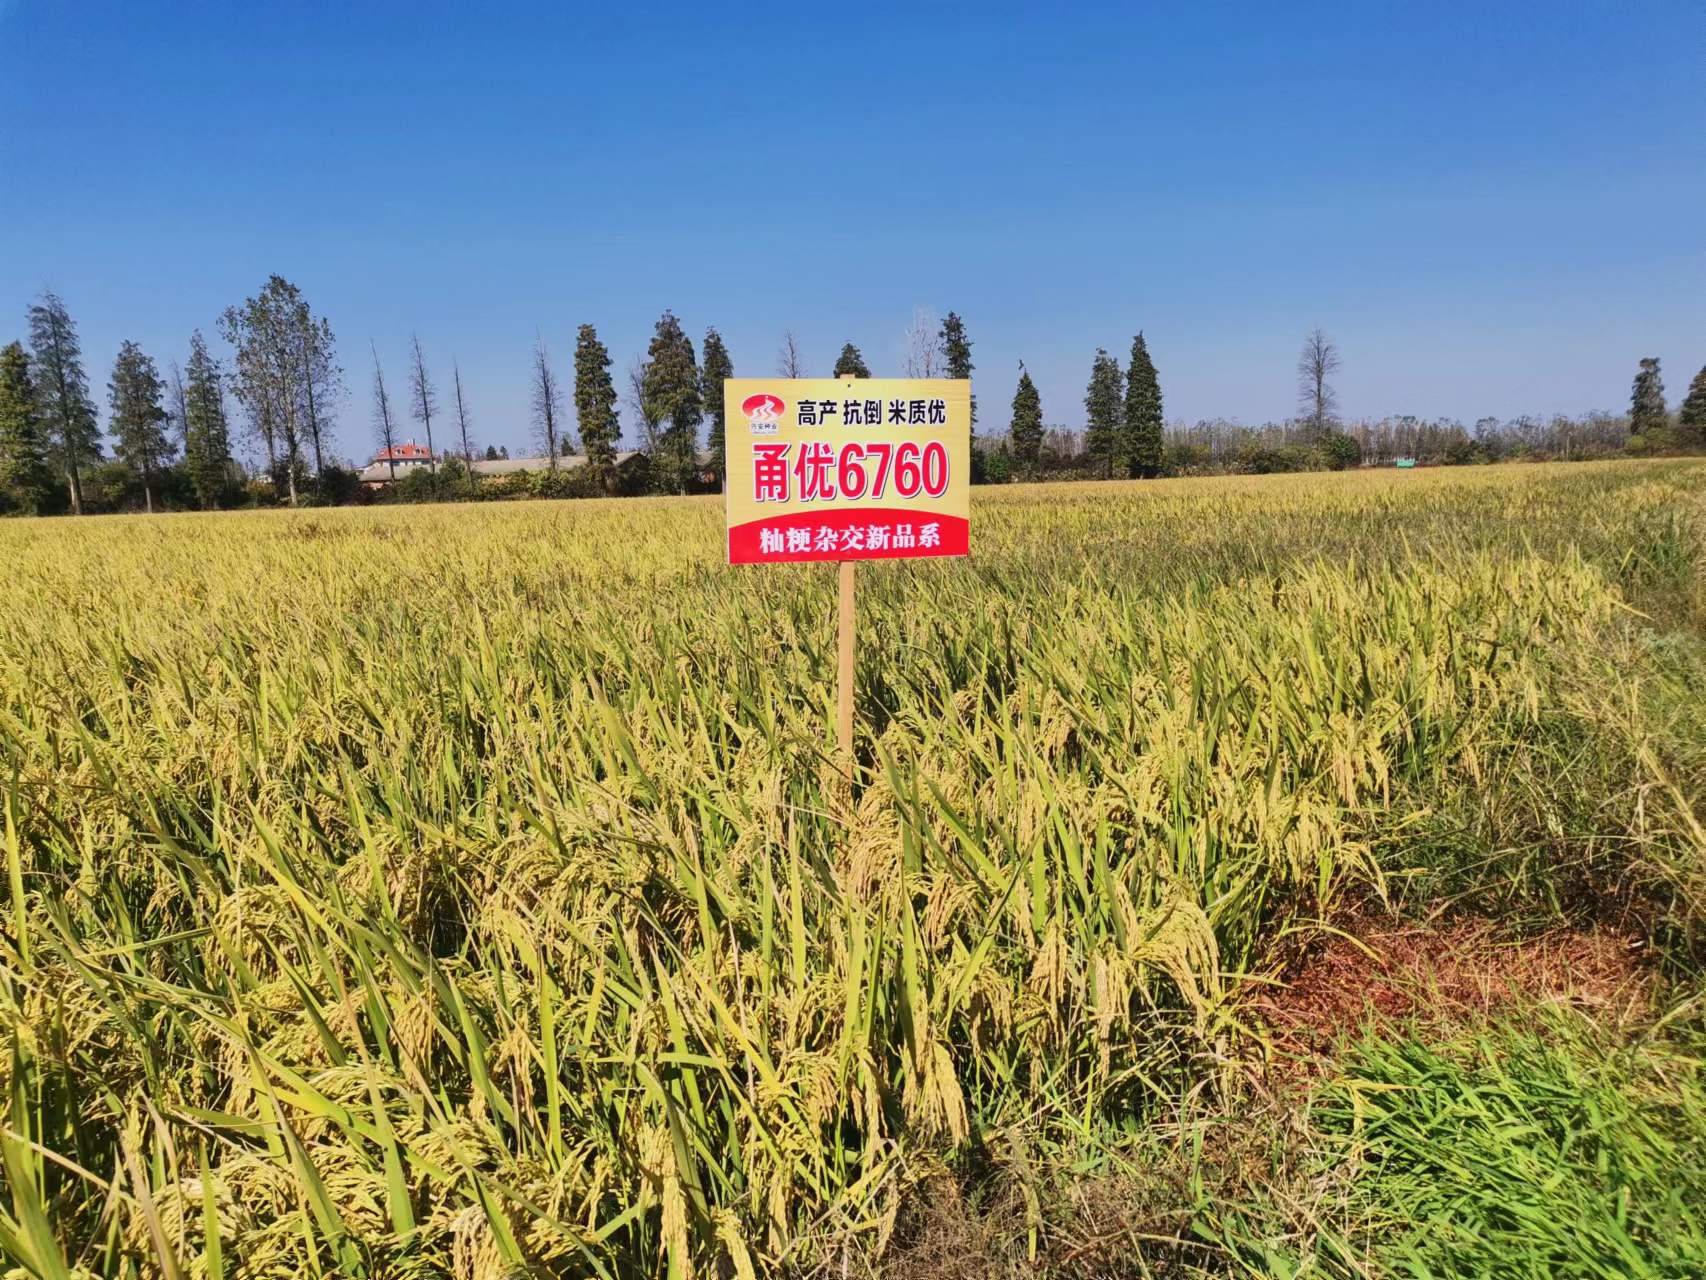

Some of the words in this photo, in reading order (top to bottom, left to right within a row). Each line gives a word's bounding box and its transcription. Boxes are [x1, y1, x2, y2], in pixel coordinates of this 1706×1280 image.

[797, 399, 837, 425] 高产
[843, 399, 882, 425] 抗倒
[888, 399, 946, 425] 米质优
[753, 441, 950, 502] 甬优6760
[759, 522, 941, 554] 籼粳杂交新品系
